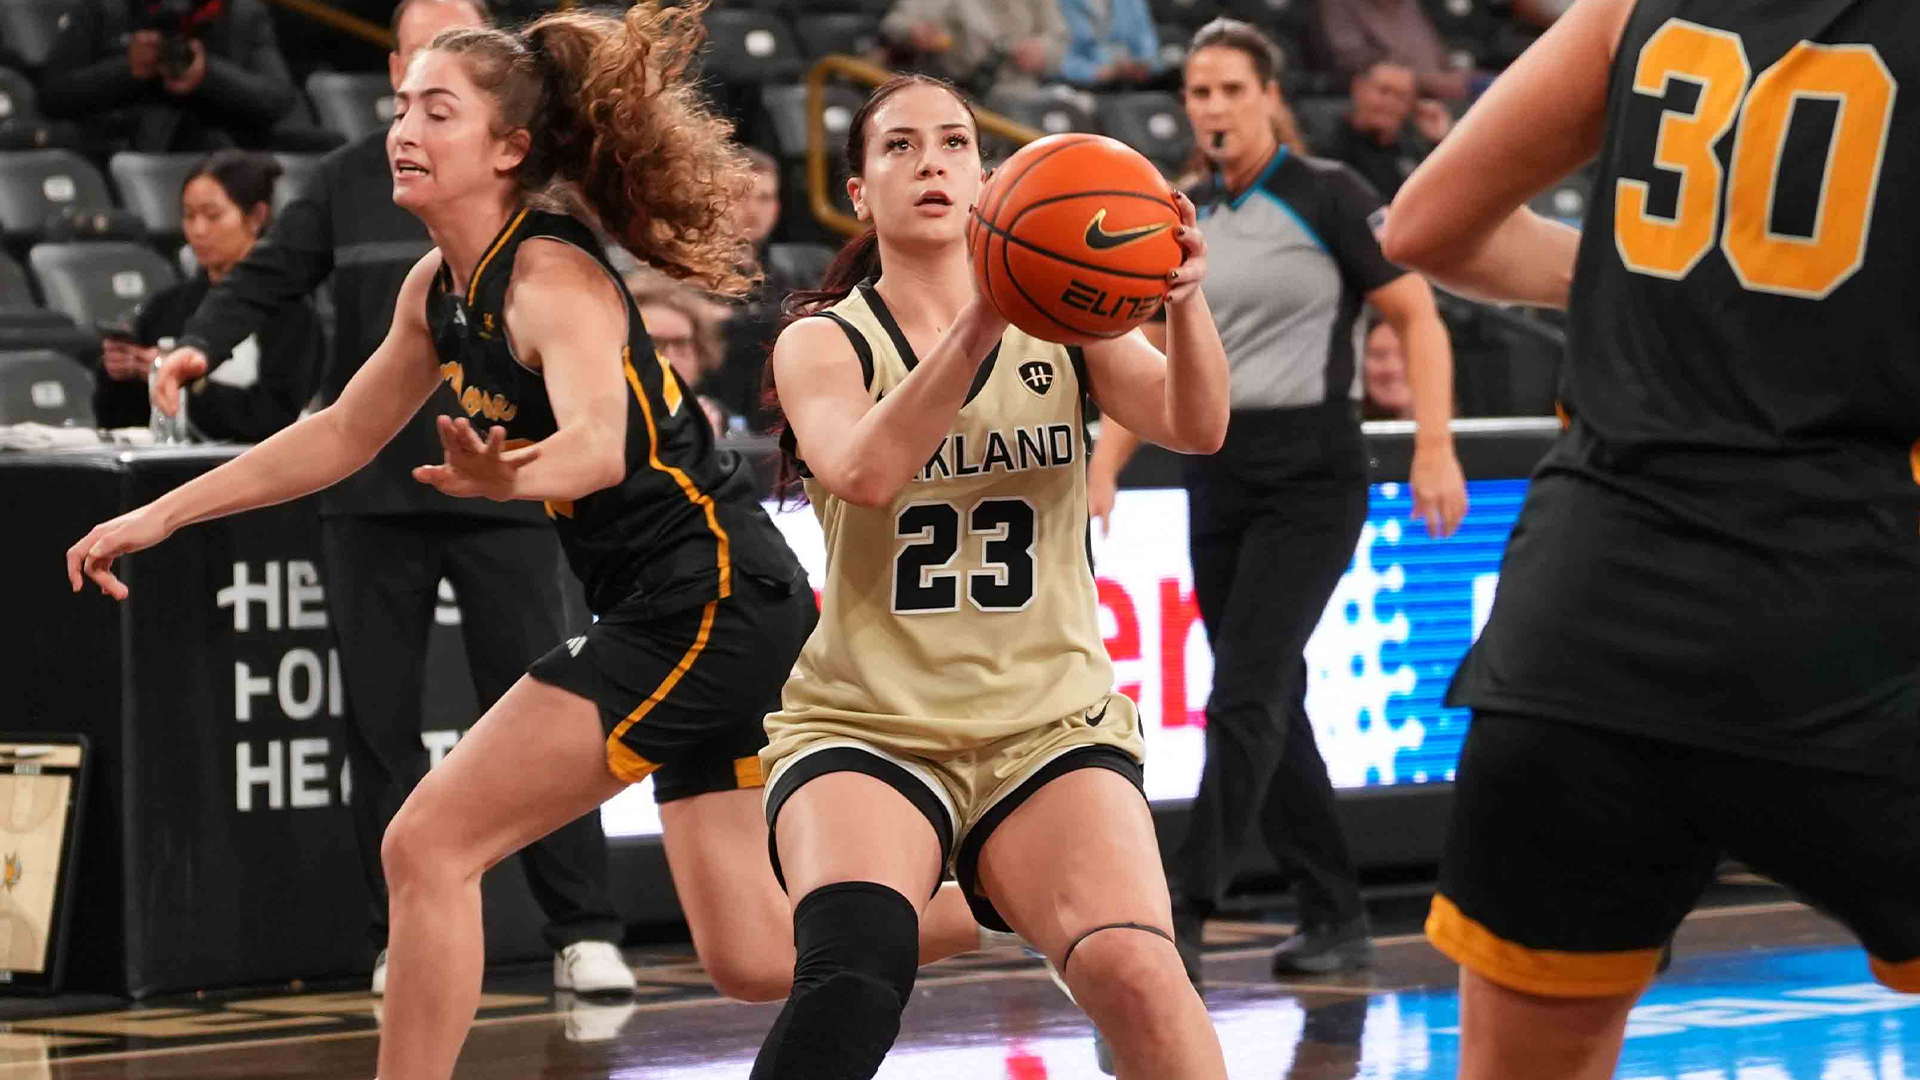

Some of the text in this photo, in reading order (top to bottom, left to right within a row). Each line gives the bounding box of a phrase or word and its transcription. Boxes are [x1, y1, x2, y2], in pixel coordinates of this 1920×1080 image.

[1614, 17, 1898, 301] 30
[1061, 278, 1162, 320] ELITE
[911, 422, 1074, 482] KLAND
[890, 495, 1039, 615] 23
